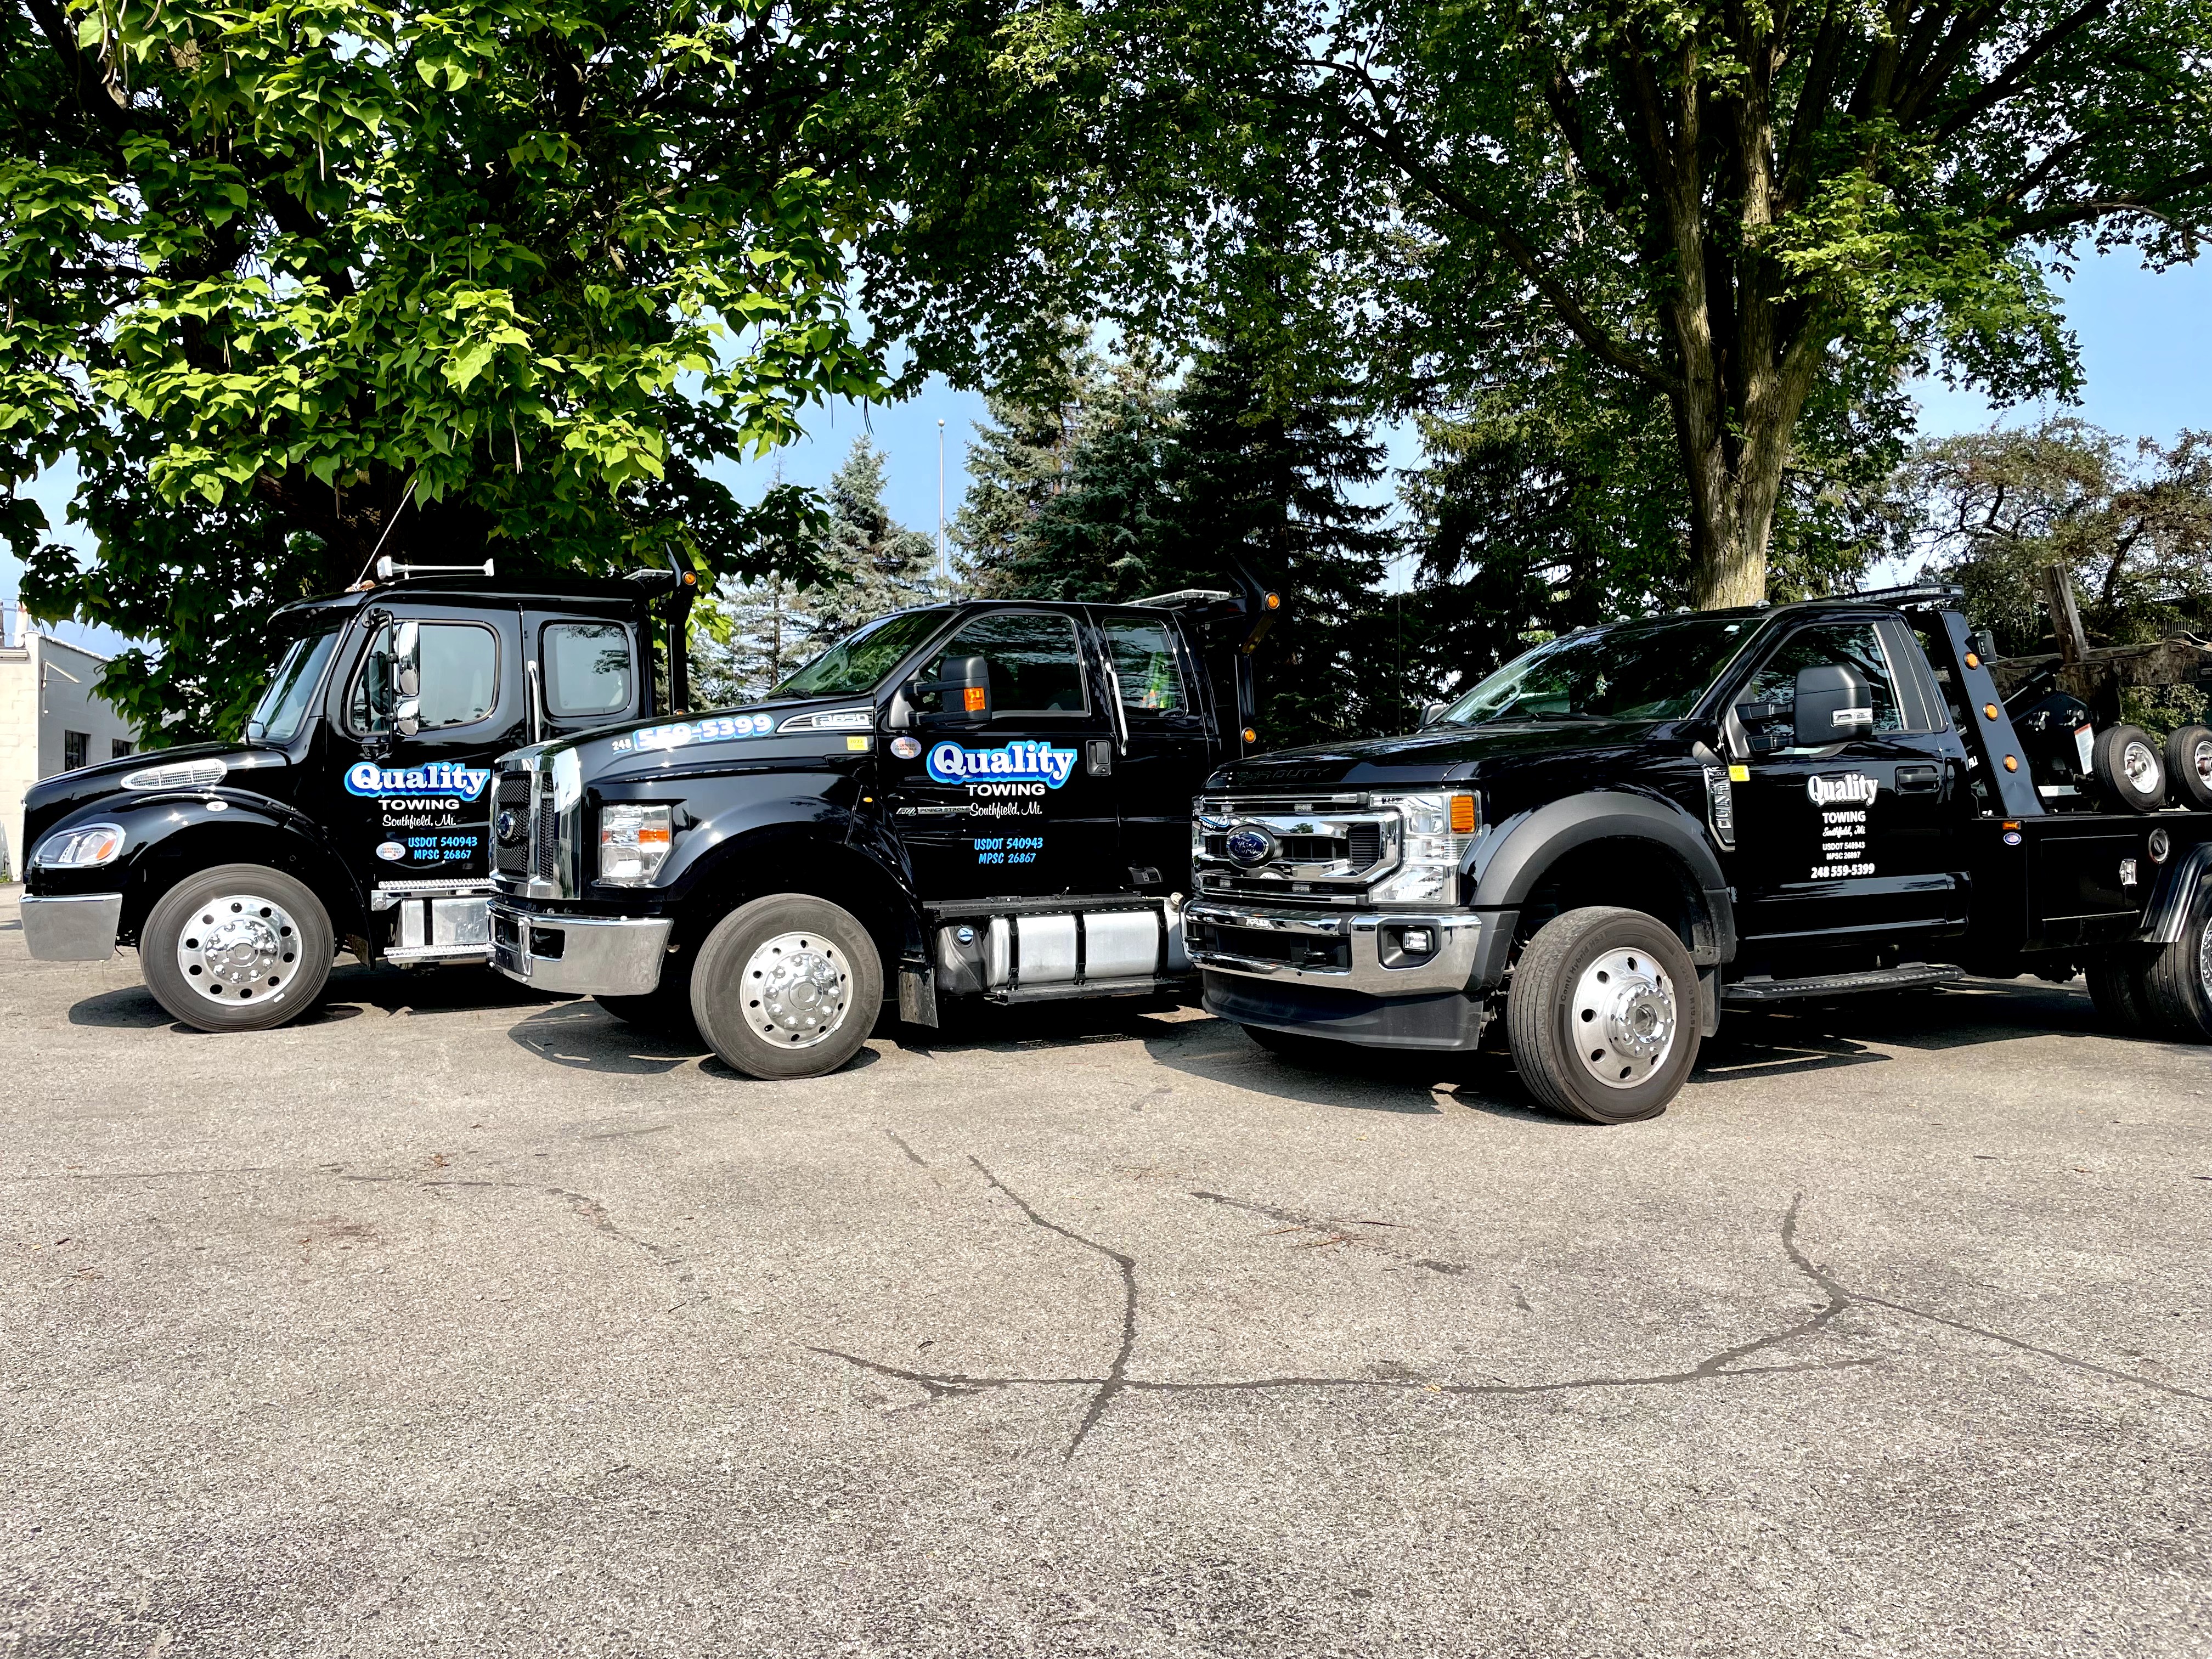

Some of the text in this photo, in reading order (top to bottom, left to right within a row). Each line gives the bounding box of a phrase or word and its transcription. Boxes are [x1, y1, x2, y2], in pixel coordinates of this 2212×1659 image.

[612, 716, 772, 751] 248 559-5399
[932, 742, 1075, 781] Quality
[349, 764, 488, 795] Quality
[966, 783, 1046, 797] TOWING
[1808, 774, 1879, 806] Quality
[378, 799, 460, 810] TOWING
[969, 801, 1042, 819] Southfield, Mi.
[382, 814, 456, 829] Southfield, Mi.
[1822, 810, 1866, 823] TOWING
[408, 836, 478, 848] USDOT 540943
[974, 837, 1043, 850] USDOT 540943
[1822, 841, 1865, 851] USDOT 540943
[414, 850, 472, 860] MPSC 26867
[978, 853, 1036, 864] MPSC 26867
[1826, 852, 1844, 860] MPSC
[1810, 862, 1875, 878] 248 559-5399
[1560, 975, 1573, 1002] Conti
[1569, 946, 1589, 974] Hybrid
